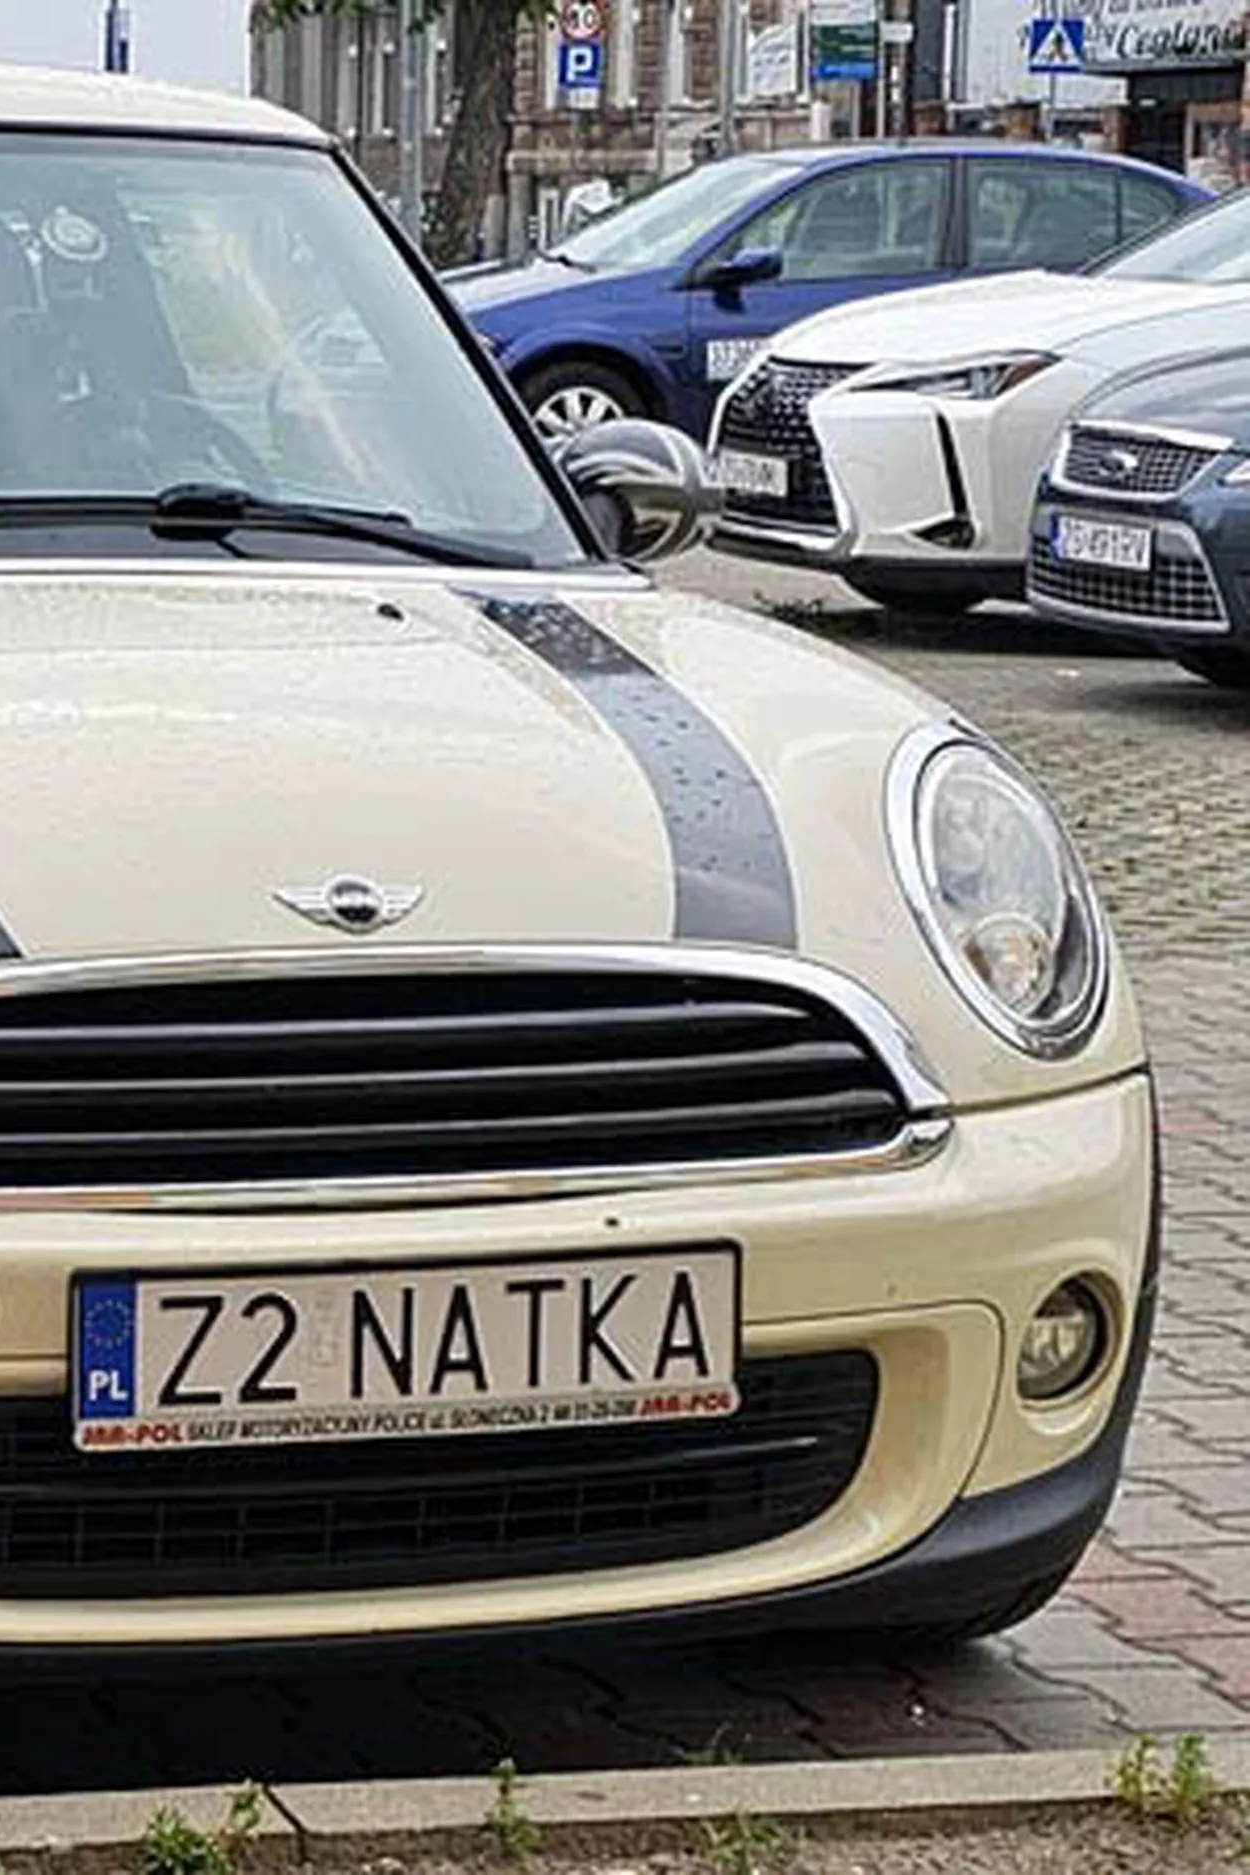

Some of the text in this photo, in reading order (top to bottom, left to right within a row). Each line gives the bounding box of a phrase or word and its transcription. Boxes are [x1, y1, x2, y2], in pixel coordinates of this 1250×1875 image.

[567, 47, 593, 82] P
[157, 1270, 710, 1407] Z2 NATKA
[88, 1369, 129, 1402] PL
